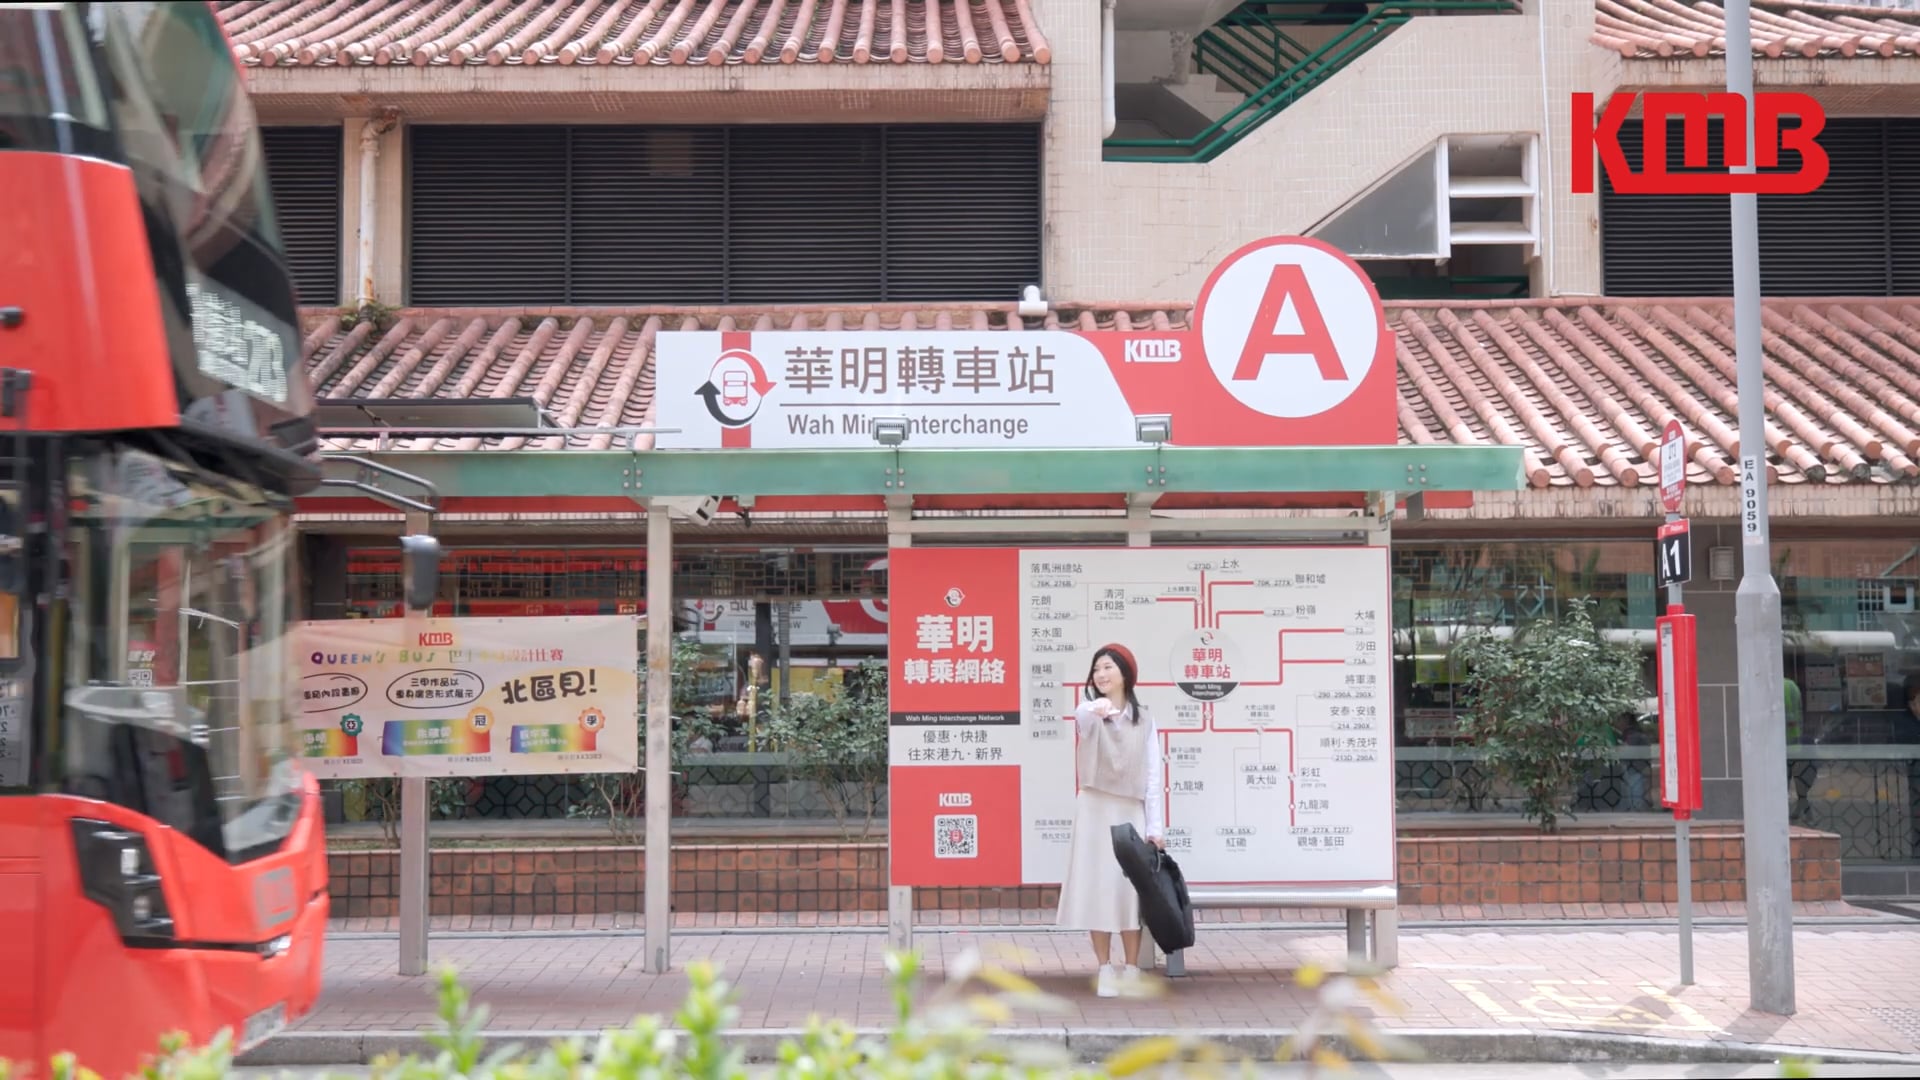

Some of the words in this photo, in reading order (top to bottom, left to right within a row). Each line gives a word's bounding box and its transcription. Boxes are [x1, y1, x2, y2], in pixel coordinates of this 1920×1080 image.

[1232, 263, 1349, 380] A
[1124, 339, 1182, 363] KMB
[784, 345, 1057, 395] 華明轉車站
[787, 414, 834, 435] Wah
[907, 413, 1029, 439] nterchange
[1745, 488, 1758, 532] 9059
[1220, 559, 1240, 569] 上水
[1662, 539, 1681, 579] A1
[1031, 563, 1083, 574] 落馬洲總站
[1295, 573, 1326, 585] 聯和墟
[1104, 589, 1125, 600] 清河
[1031, 595, 1052, 606] 元朗
[1094, 600, 1125, 611] 百和路
[1295, 605, 1316, 615] 粉嶺
[1354, 610, 1375, 620] 大埔
[916, 615, 994, 653] 華明
[1031, 627, 1062, 638] 天水圍
[418, 632, 454, 647] KMB
[1355, 641, 1376, 651] 沙田
[311, 650, 387, 665] QUEEN'S
[399, 650, 436, 663] BUS
[1192, 648, 1223, 662] 華明
[904, 658, 1006, 684] 轉乘網絡
[1031, 664, 1052, 674] 機場
[1184, 664, 1231, 679] 轉車站
[1345, 674, 1376, 685] 將軍澳
[1032, 698, 1053, 708] 青衣
[905, 714, 920, 722] Wah
[921, 714, 938, 723] Ming
[939, 714, 978, 723] Interchange
[978, 714, 1005, 722] Network
[923, 730, 988, 744] 優惠·快捷
[908, 747, 1003, 761] 往來港九·新界
[1300, 768, 1321, 777] 彩虹
[1246, 775, 1277, 785] 黃大仙
[1172, 781, 1204, 792] 九龍塘
[939, 793, 972, 807] KMB
